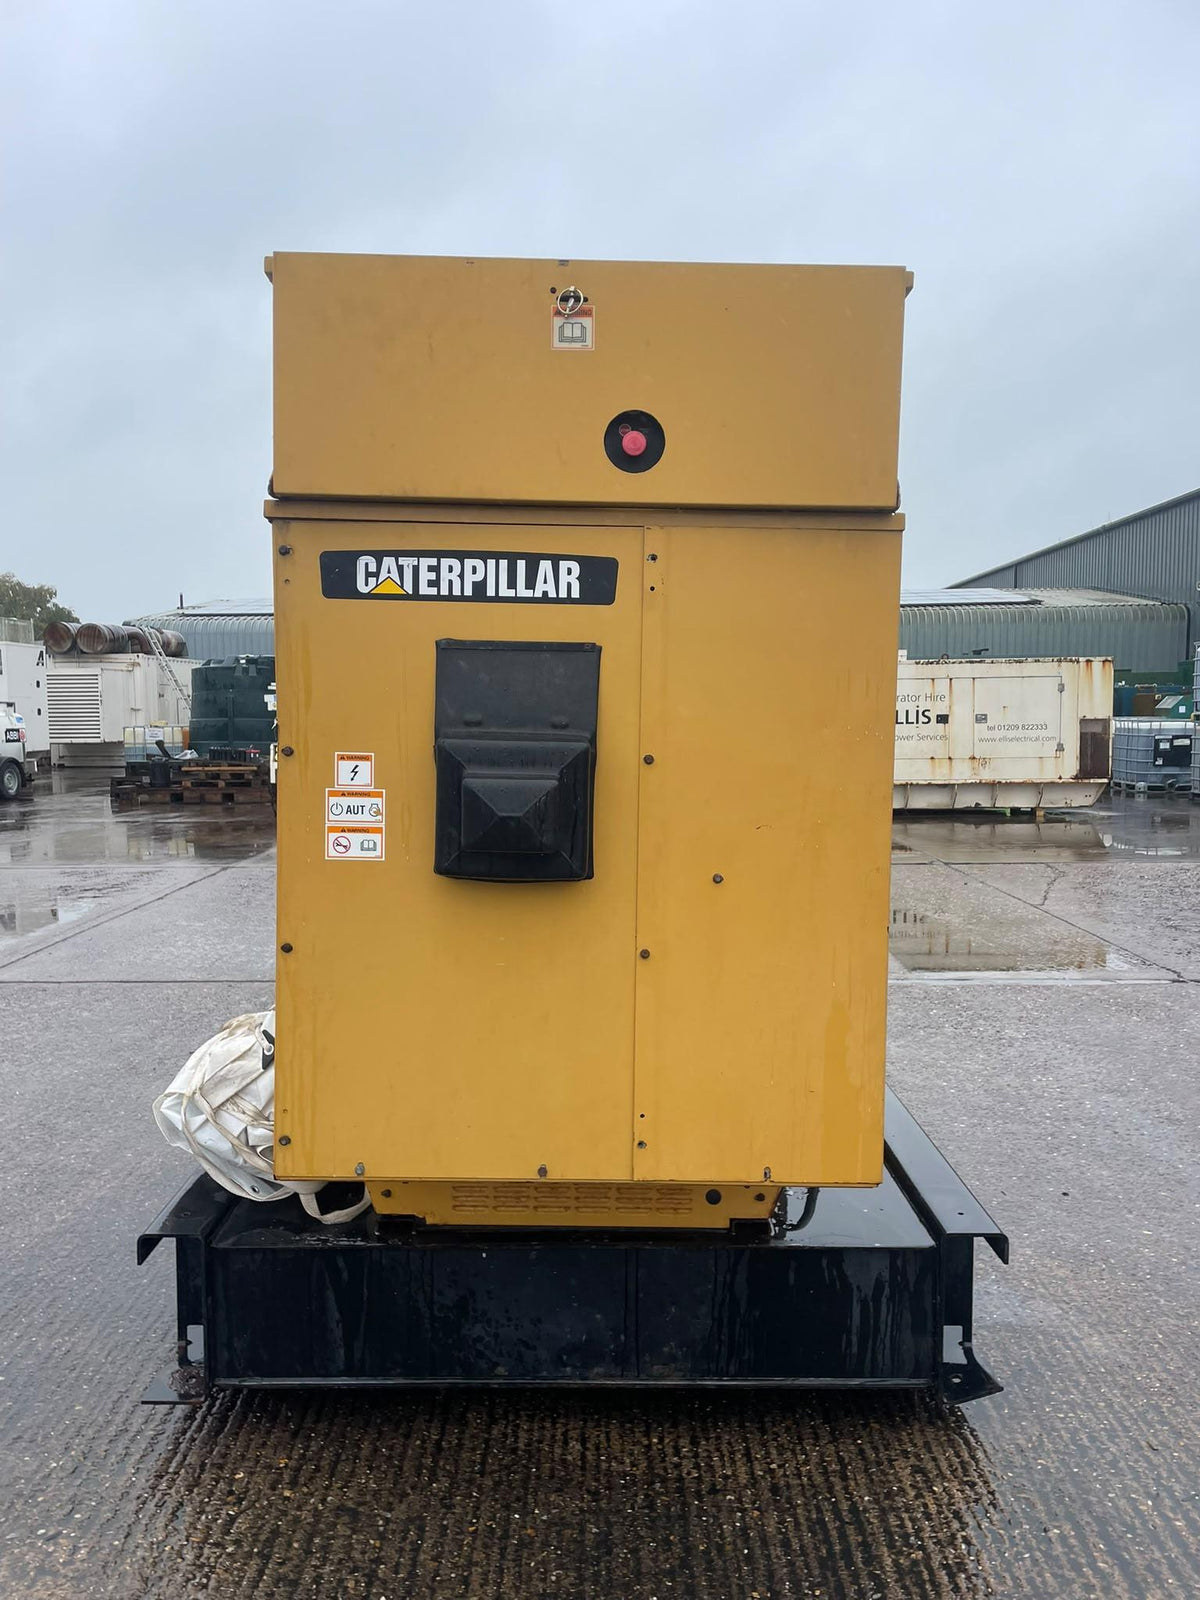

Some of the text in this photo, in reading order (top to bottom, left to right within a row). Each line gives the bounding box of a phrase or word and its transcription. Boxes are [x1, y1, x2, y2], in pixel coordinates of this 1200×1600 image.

[356, 555, 581, 599] CATERPILLAR
[925, 692, 946, 702] Hire
[916, 732, 949, 741] Services
[345, 805, 366, 815] AUT
